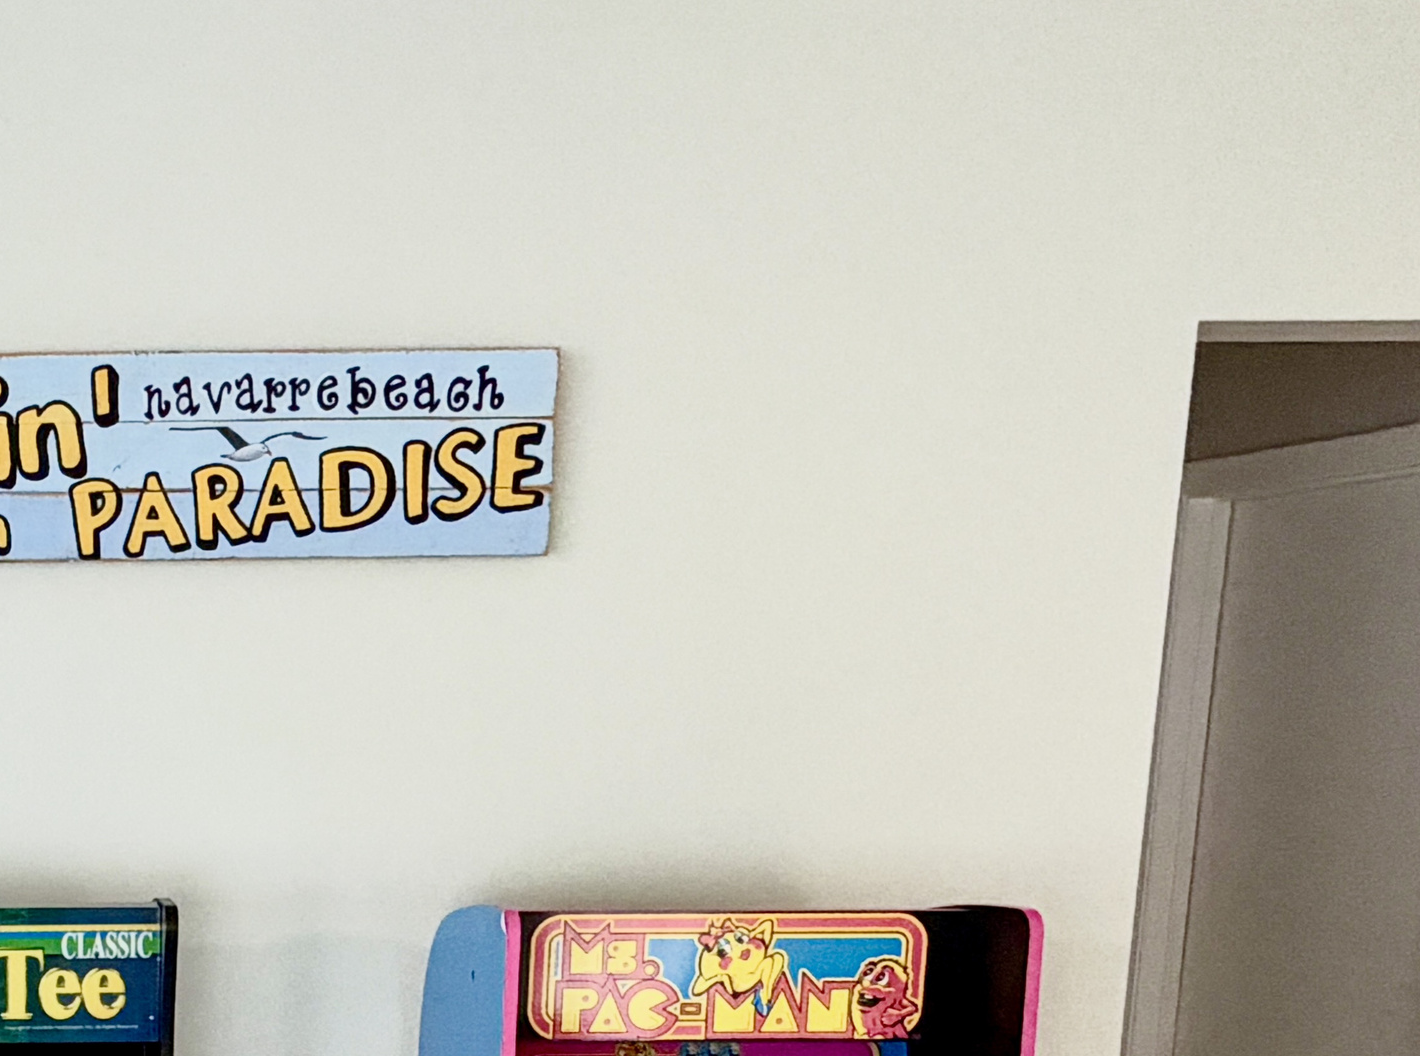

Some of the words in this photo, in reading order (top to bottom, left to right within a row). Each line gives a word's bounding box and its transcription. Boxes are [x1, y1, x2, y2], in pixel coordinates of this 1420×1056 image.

[68, 423, 545, 560] PARADISE
[60, 931, 154, 960] CLASSIC
[554, 970, 855, 1039] PAC-MAN
